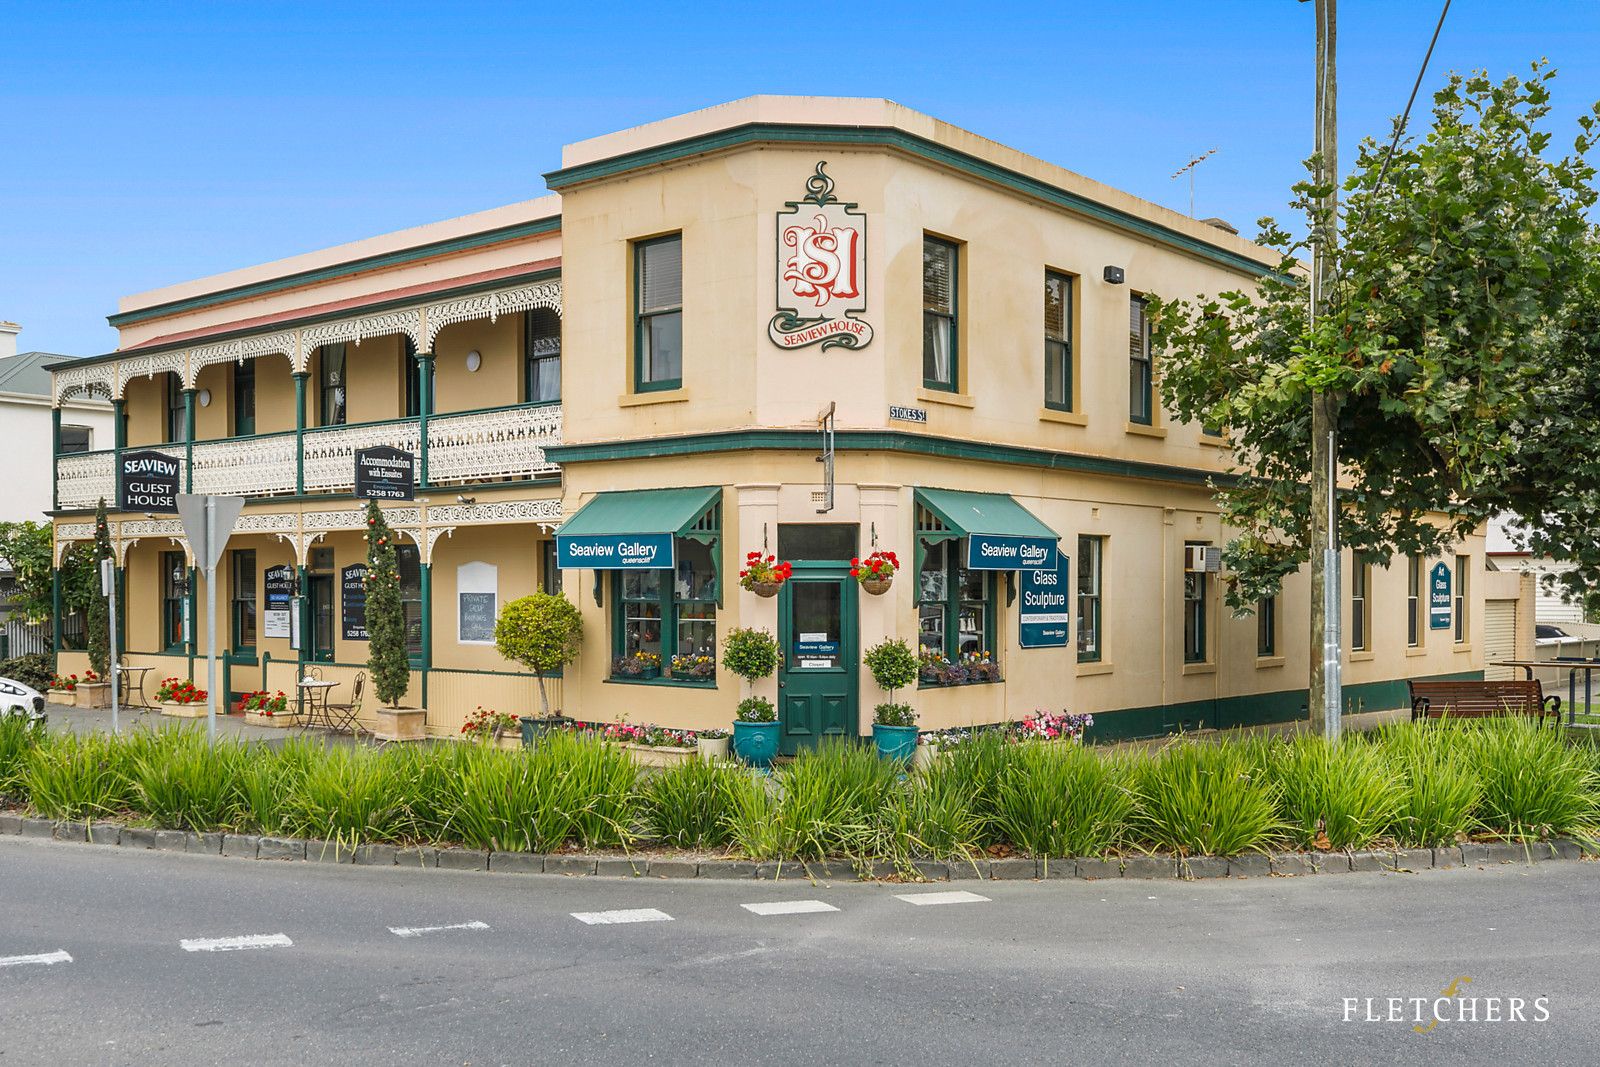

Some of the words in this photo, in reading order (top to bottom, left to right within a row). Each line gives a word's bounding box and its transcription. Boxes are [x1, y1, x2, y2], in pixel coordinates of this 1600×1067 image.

[784, 324, 828, 346] SEAVIEW
[829, 320, 866, 336] HOUSE
[890, 407, 917, 420] STOKES
[124, 459, 177, 476] SEAVIEW
[360, 453, 411, 469] Accommodation
[368, 467, 381, 477] with
[381, 467, 403, 479] Ensuites
[129, 482, 172, 494] GUEST
[366, 489, 387, 497] 5258
[387, 490, 405, 498] 1763
[127, 494, 173, 507] HOUSE
[569, 542, 614, 557] Seaview
[618, 542, 658, 559] Gallery
[981, 542, 1018, 557] Seaview
[1019, 544, 1049, 561] Gallery
[1033, 570, 1058, 585] Glass
[1435, 580, 1447, 590] Glass
[1024, 591, 1065, 609] Sculpture
[1432, 593, 1450, 604] Sculpture
